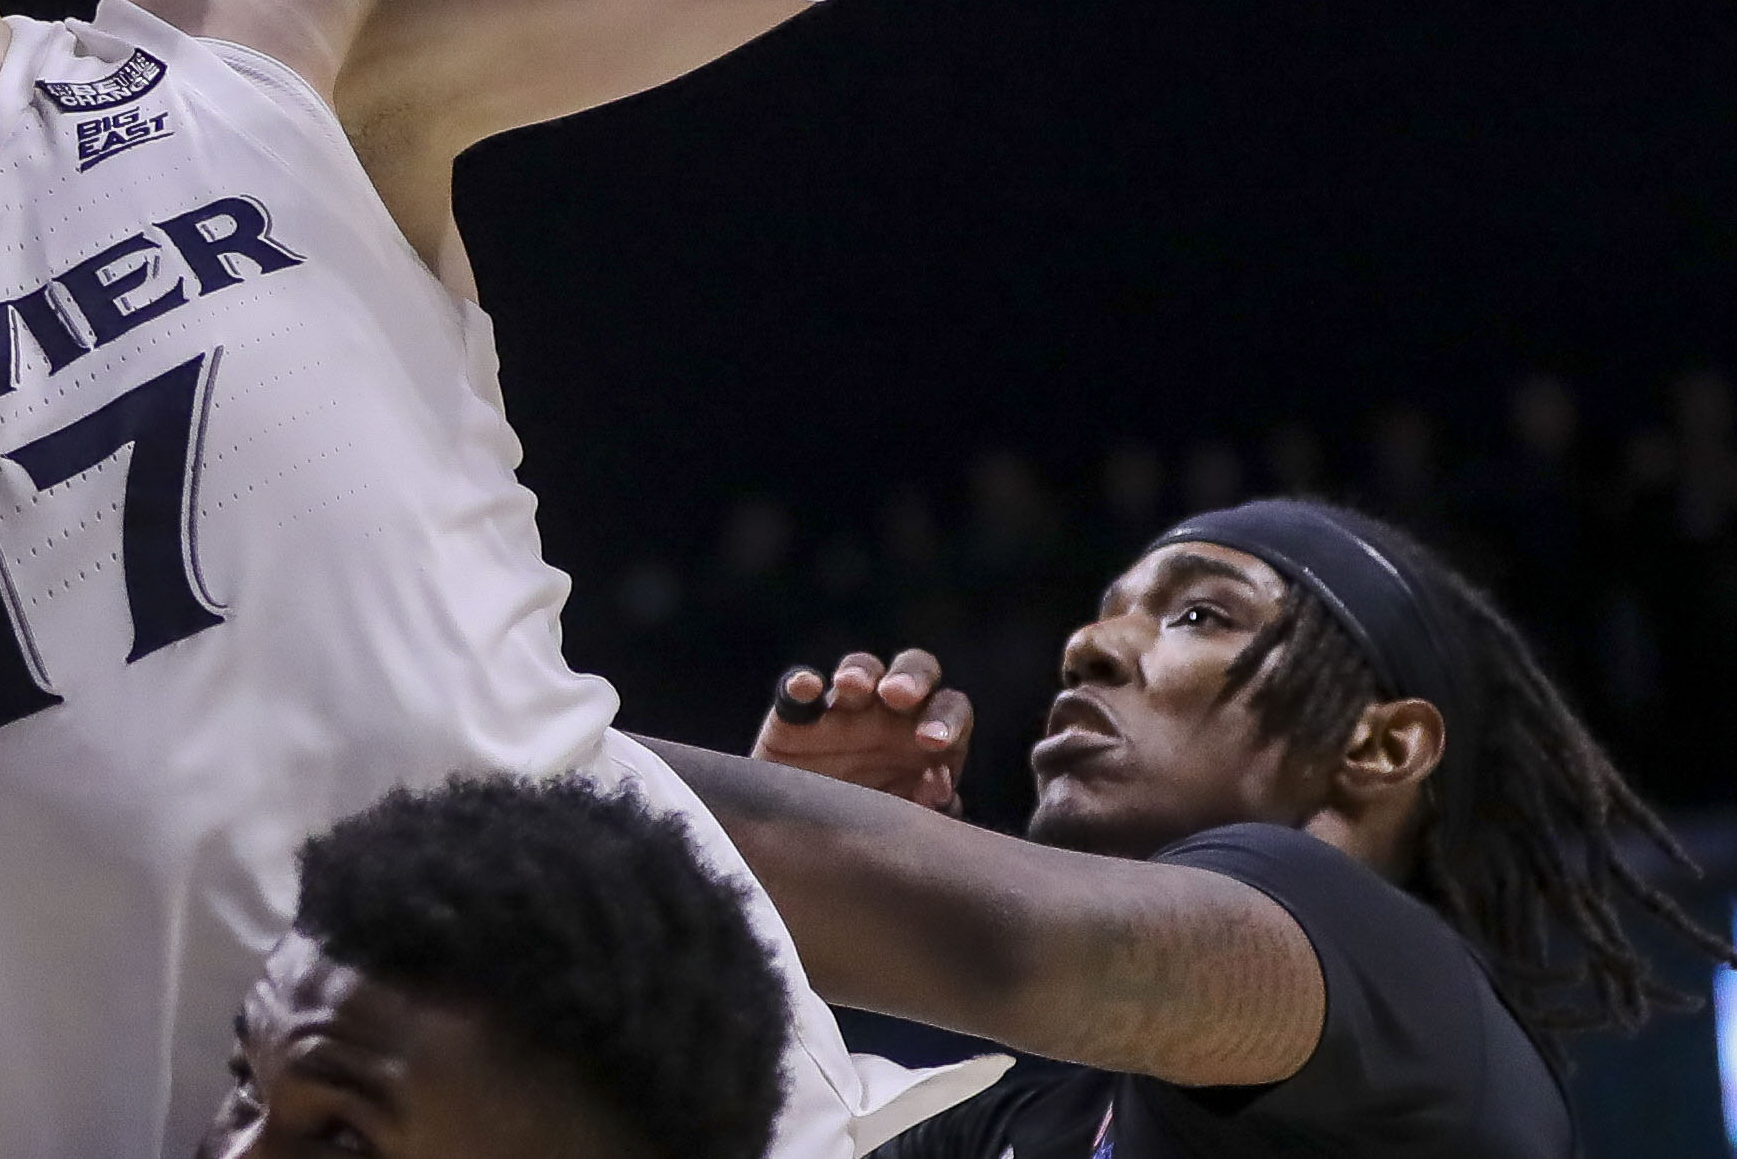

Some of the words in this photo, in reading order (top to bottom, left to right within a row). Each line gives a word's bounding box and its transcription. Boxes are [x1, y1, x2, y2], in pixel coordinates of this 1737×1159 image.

[59, 62, 161, 106] CHANGE
[76, 106, 140, 142] BIG
[78, 112, 168, 160] EAST
